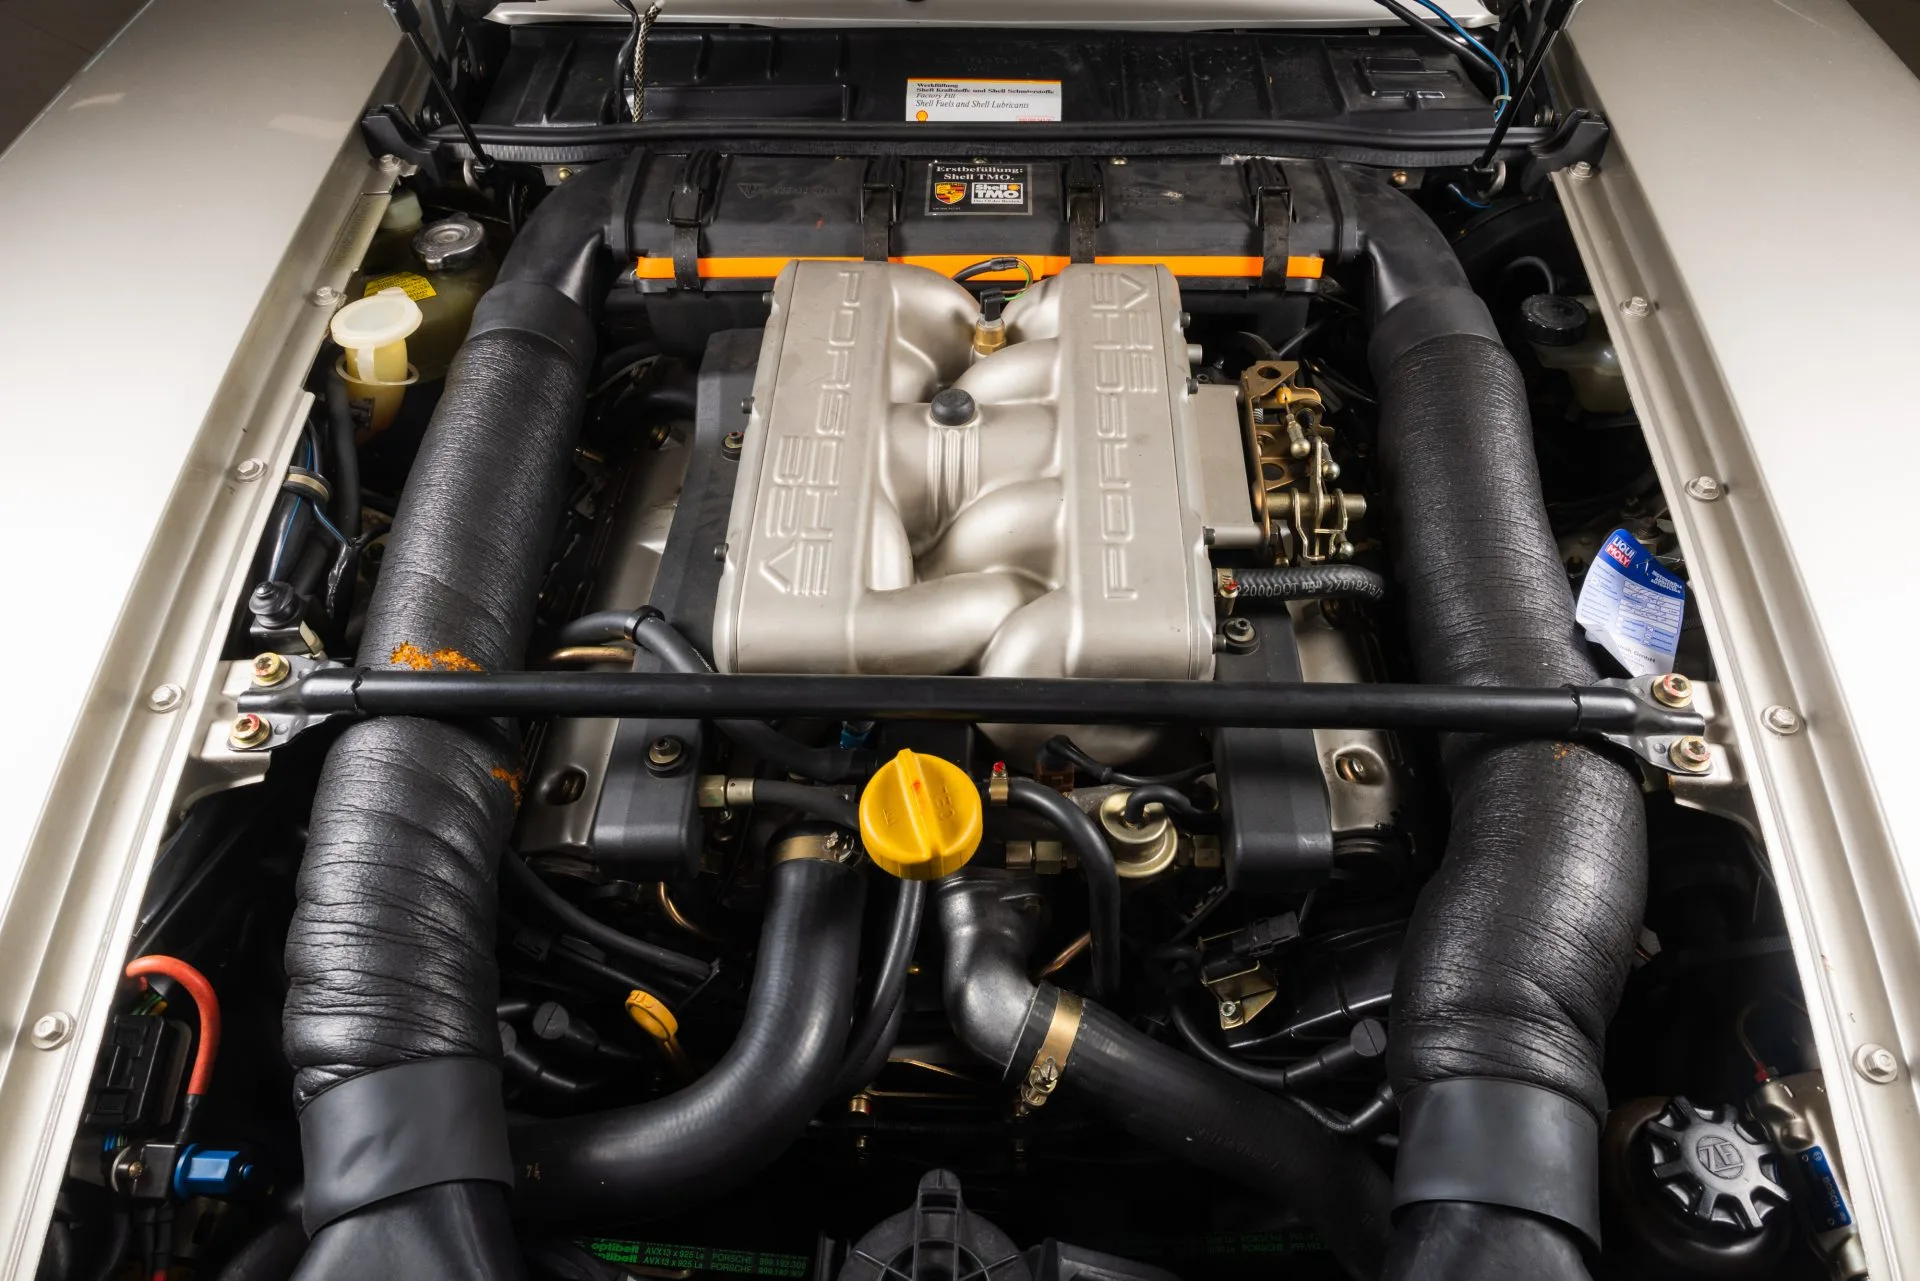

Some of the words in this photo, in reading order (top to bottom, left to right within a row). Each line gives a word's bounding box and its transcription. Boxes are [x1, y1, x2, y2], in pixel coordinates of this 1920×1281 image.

[915, 99, 933, 107] Shell
[972, 100, 990, 108] Shell
[991, 100, 1029, 109] Lubricants
[936, 166, 1023, 174] Erstbefüllung:
[975, 190, 1019, 198] TMO
[1120, 272, 1158, 394] 32V
[793, 269, 864, 598] PORSCHE
[1091, 271, 1138, 602] PORSCHE
[758, 434, 807, 595] 32V
[1607, 544, 1631, 566] MOLY
[1613, 536, 1635, 558] LIQUI
[1698, 1142, 1744, 1172] ZF
[1823, 1176, 1841, 1209] BOSCH
[590, 1242, 640, 1254] optibelt
[679, 1249, 694, 1259] 925
[712, 1252, 753, 1265] PORSCHE
[678, 1259, 692, 1268] 925
[694, 1260, 703, 1269] La
[710, 1262, 752, 1273] PORSCHE
